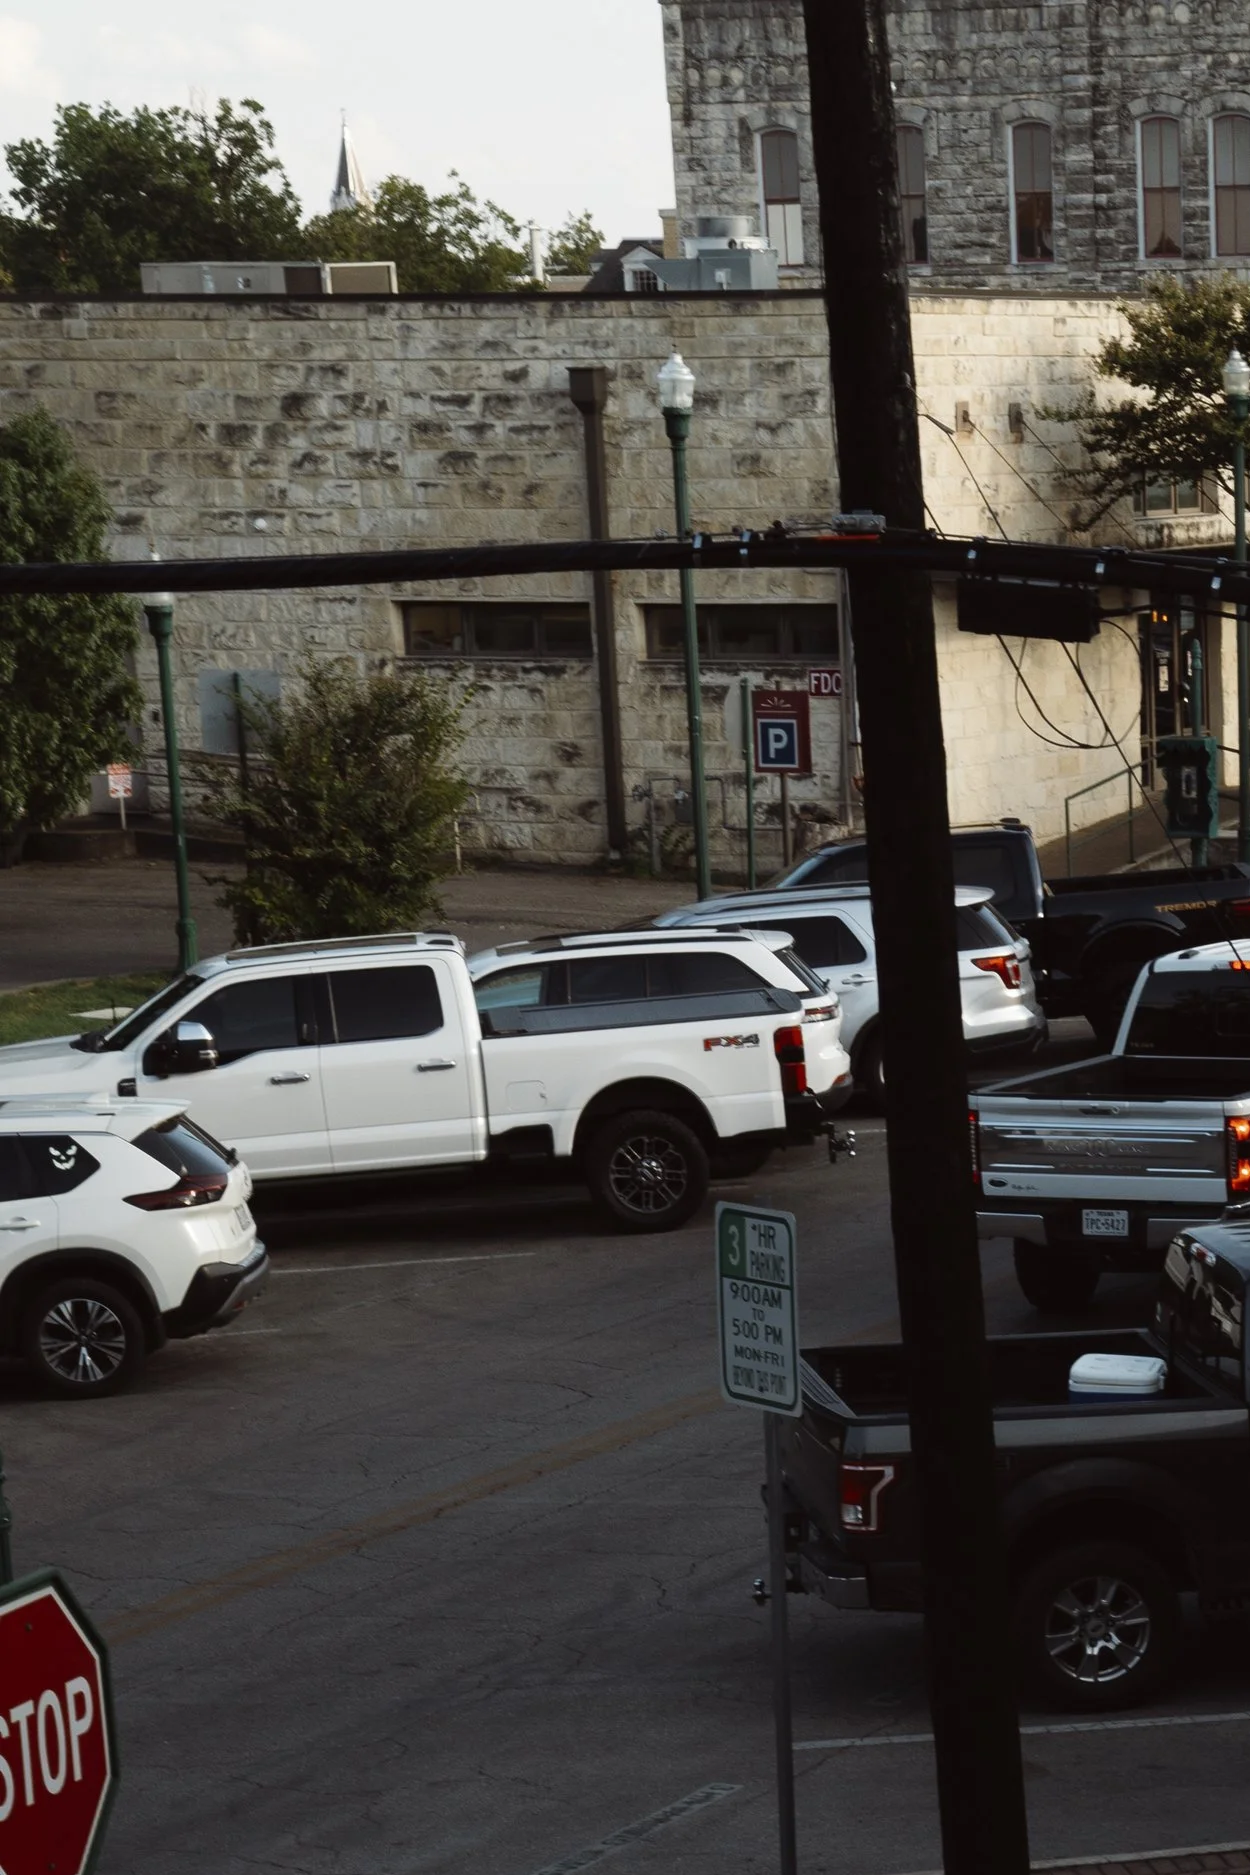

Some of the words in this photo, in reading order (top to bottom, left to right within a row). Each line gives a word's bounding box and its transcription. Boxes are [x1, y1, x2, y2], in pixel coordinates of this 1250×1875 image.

[768, 727, 788, 759] P
[1154, 899, 1218, 913] TREMOR
[703, 1033, 760, 1052] FX4
[728, 1224, 740, 1266] 3
[757, 1223, 777, 1250] HR
[750, 1250, 786, 1283] PARKING
[751, 1307, 766, 1322] TO
[764, 1323, 784, 1347] PM
[733, 1344, 785, 1368] MON-FRI
[0, 1675, 94, 1822] STOP
